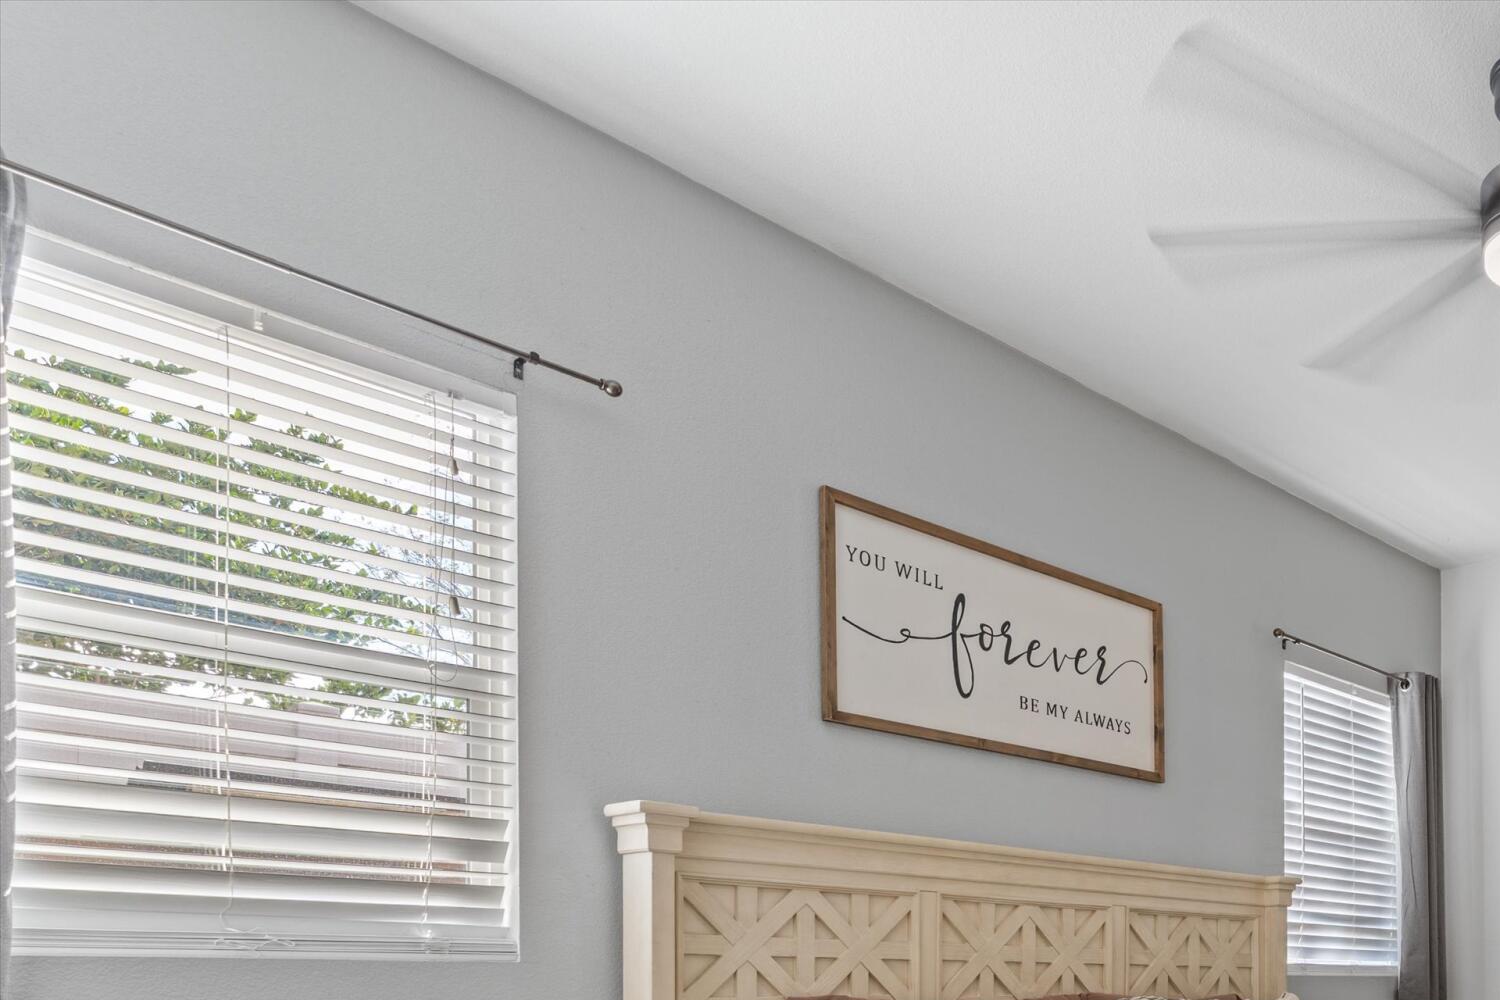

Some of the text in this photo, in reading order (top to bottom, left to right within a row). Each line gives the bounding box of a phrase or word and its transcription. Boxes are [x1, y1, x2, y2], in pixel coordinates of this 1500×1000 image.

[845, 544, 944, 590] YOU WILL
[842, 593, 1148, 699] forever
[1019, 695, 1132, 735] BE MY ALWAYS
